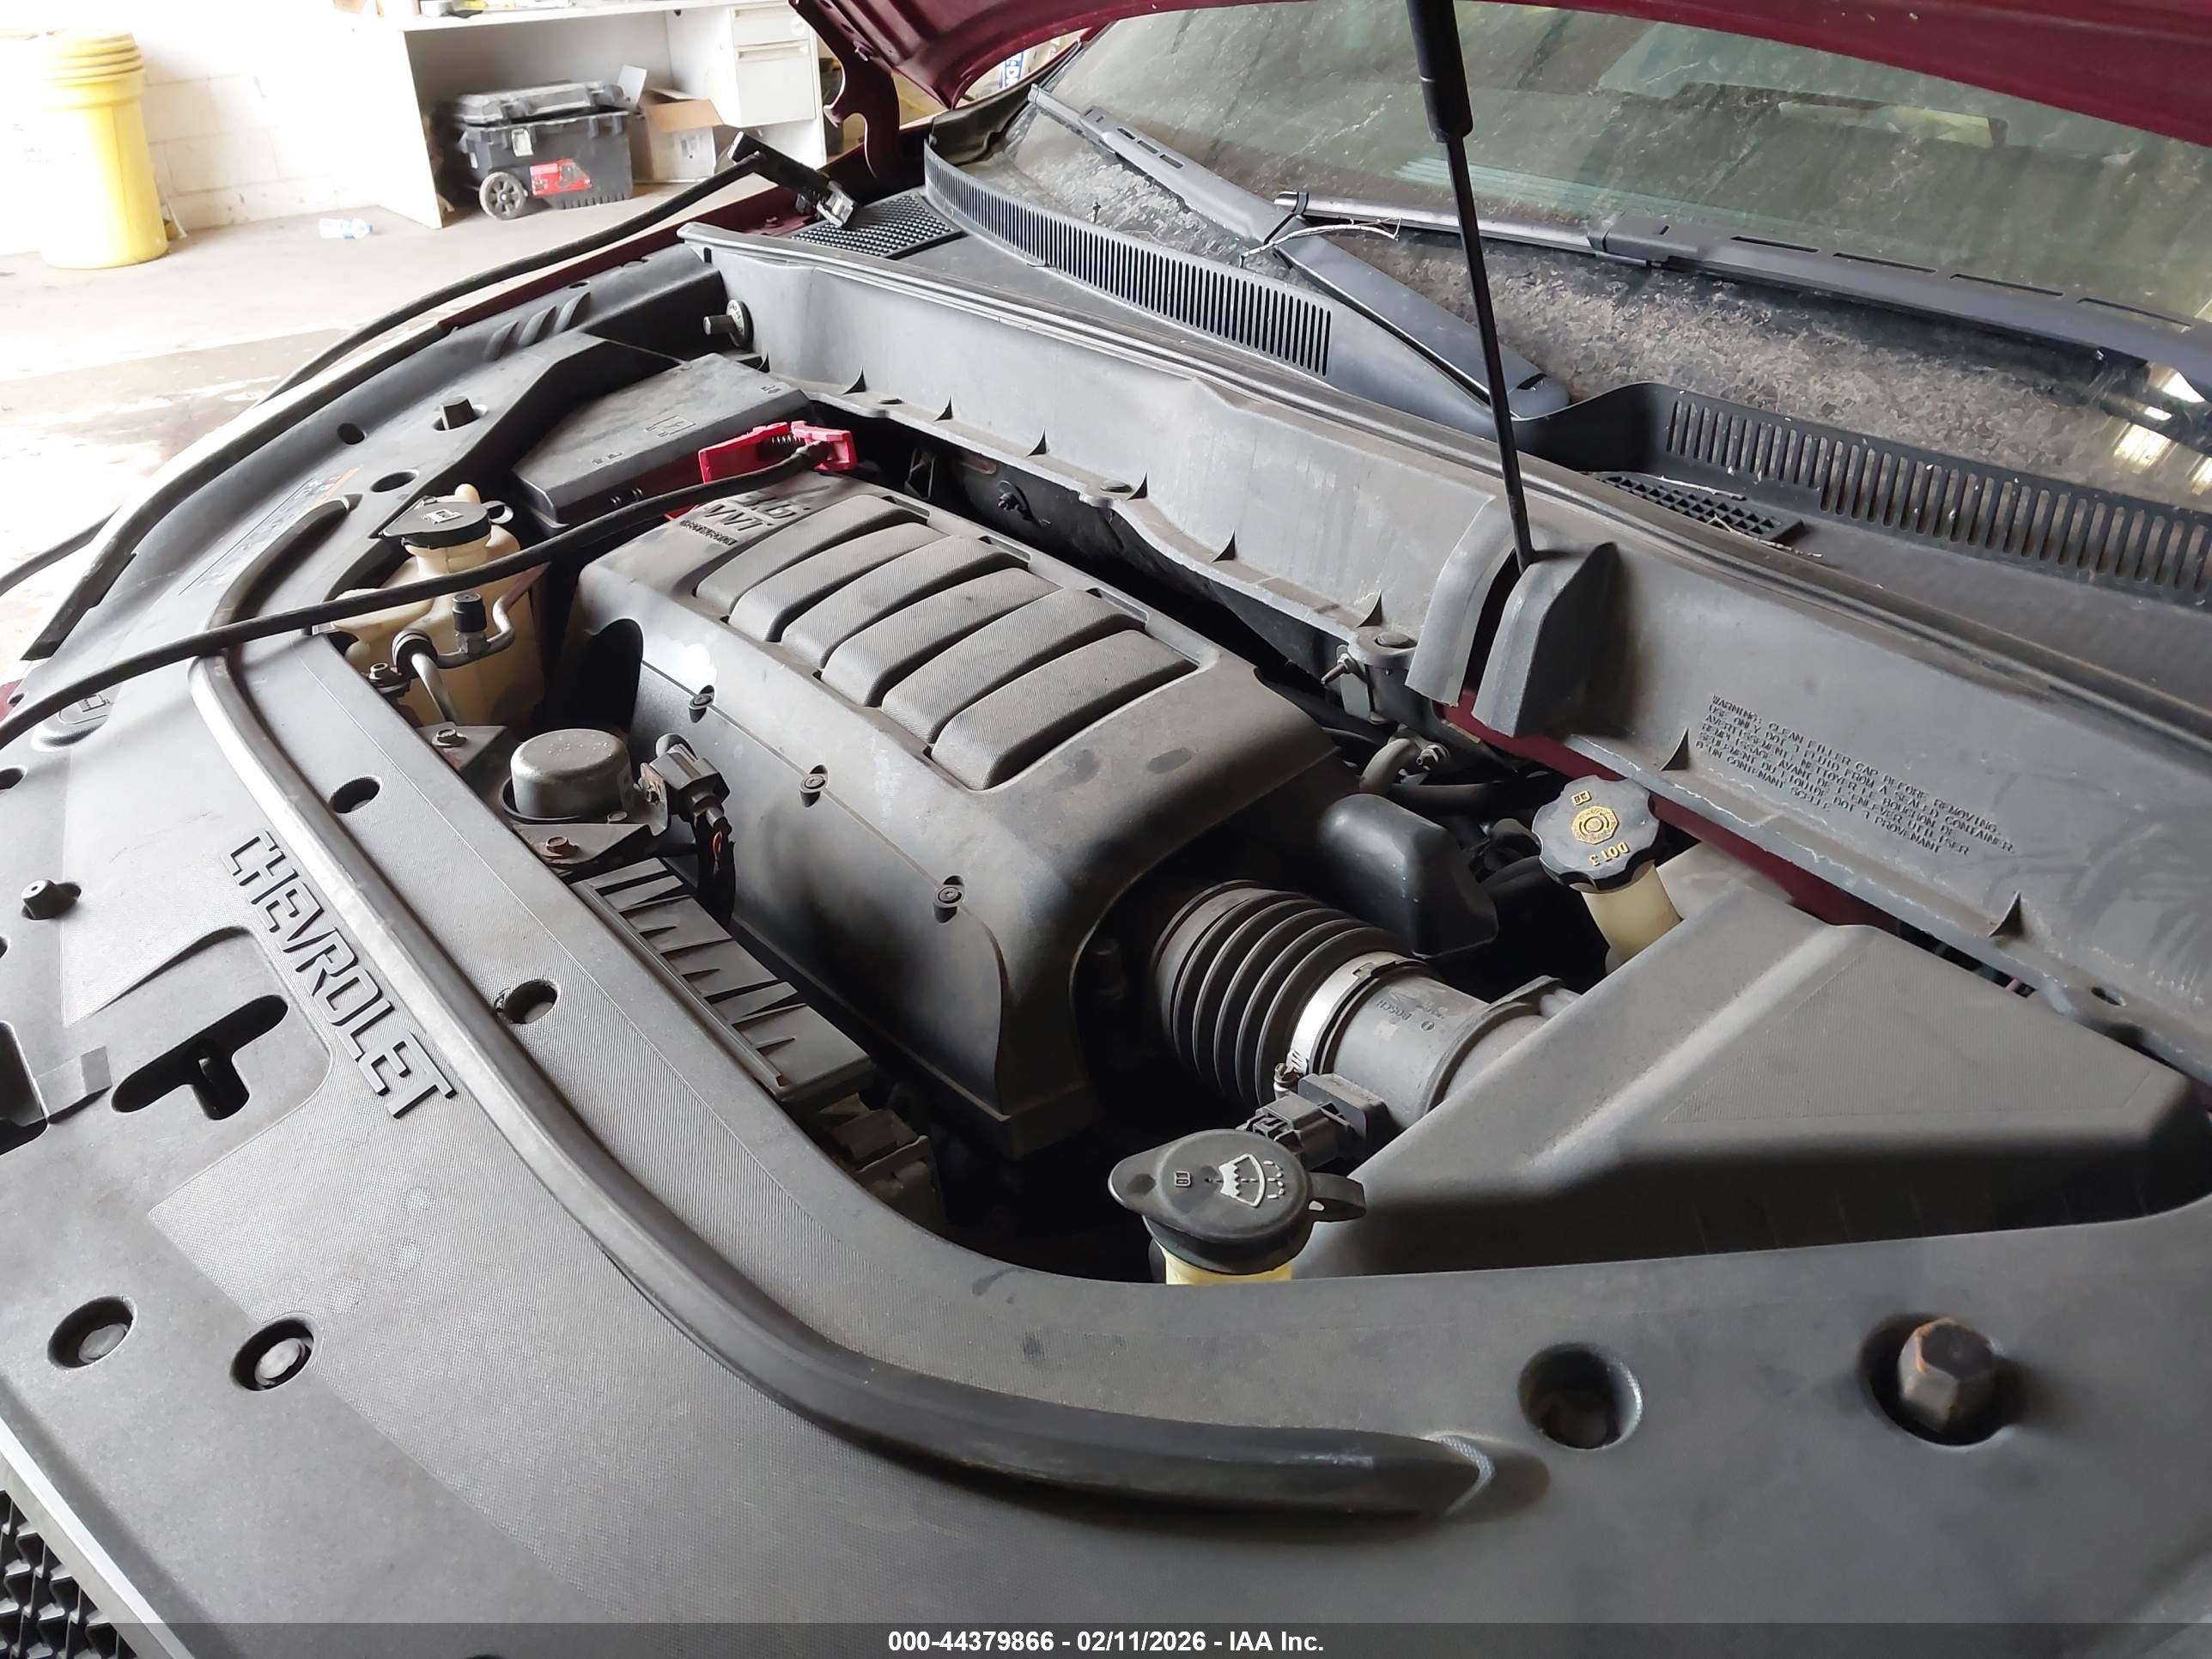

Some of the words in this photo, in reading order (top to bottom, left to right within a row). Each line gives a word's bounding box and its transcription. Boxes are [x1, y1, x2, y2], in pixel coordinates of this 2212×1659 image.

[704, 503, 764, 532] VVT
[1698, 732, 1755, 764] SEULEMENT
[1760, 762, 1776, 774] DU
[1780, 770, 1827, 798] LIQUIDE
[1832, 796, 1855, 811] DOT
[1875, 816, 1941, 853] PROVENANT
[1701, 723, 1770, 760] REMPLISSAGE
[1778, 759, 1811, 780] AVANT
[1816, 778, 1830, 789] DE
[1906, 820, 1969, 855] UTILISER
[1708, 705, 1725, 718] USE
[1733, 717, 1759, 734] ONLY
[1765, 732, 1784, 745] DOT
[1803, 750, 1839, 771] FLUID
[1844, 769, 1875, 787] FROM
[1879, 785, 1888, 794] A
[1893, 791, 1939, 817] SEALED
[1711, 696, 1762, 724] WARNING:
[1768, 722, 1802, 744] CLEAN
[1808, 740, 1850, 765] FILLER
[1855, 763, 1878, 778] CAP
[1882, 774, 1927, 801] BEFORE
[1726, 756, 1784, 788] CONTENANT
[1800, 759, 1856, 791] NETTOYER
[1861, 788, 1876, 799] LE
[1882, 798, 1935, 828] BOUCHON
[1940, 825, 1954, 836] DE
[1589, 853, 1601, 866] 3
[1601, 842, 1630, 863] DOT
[222, 830, 458, 1120] CHEVROLET
